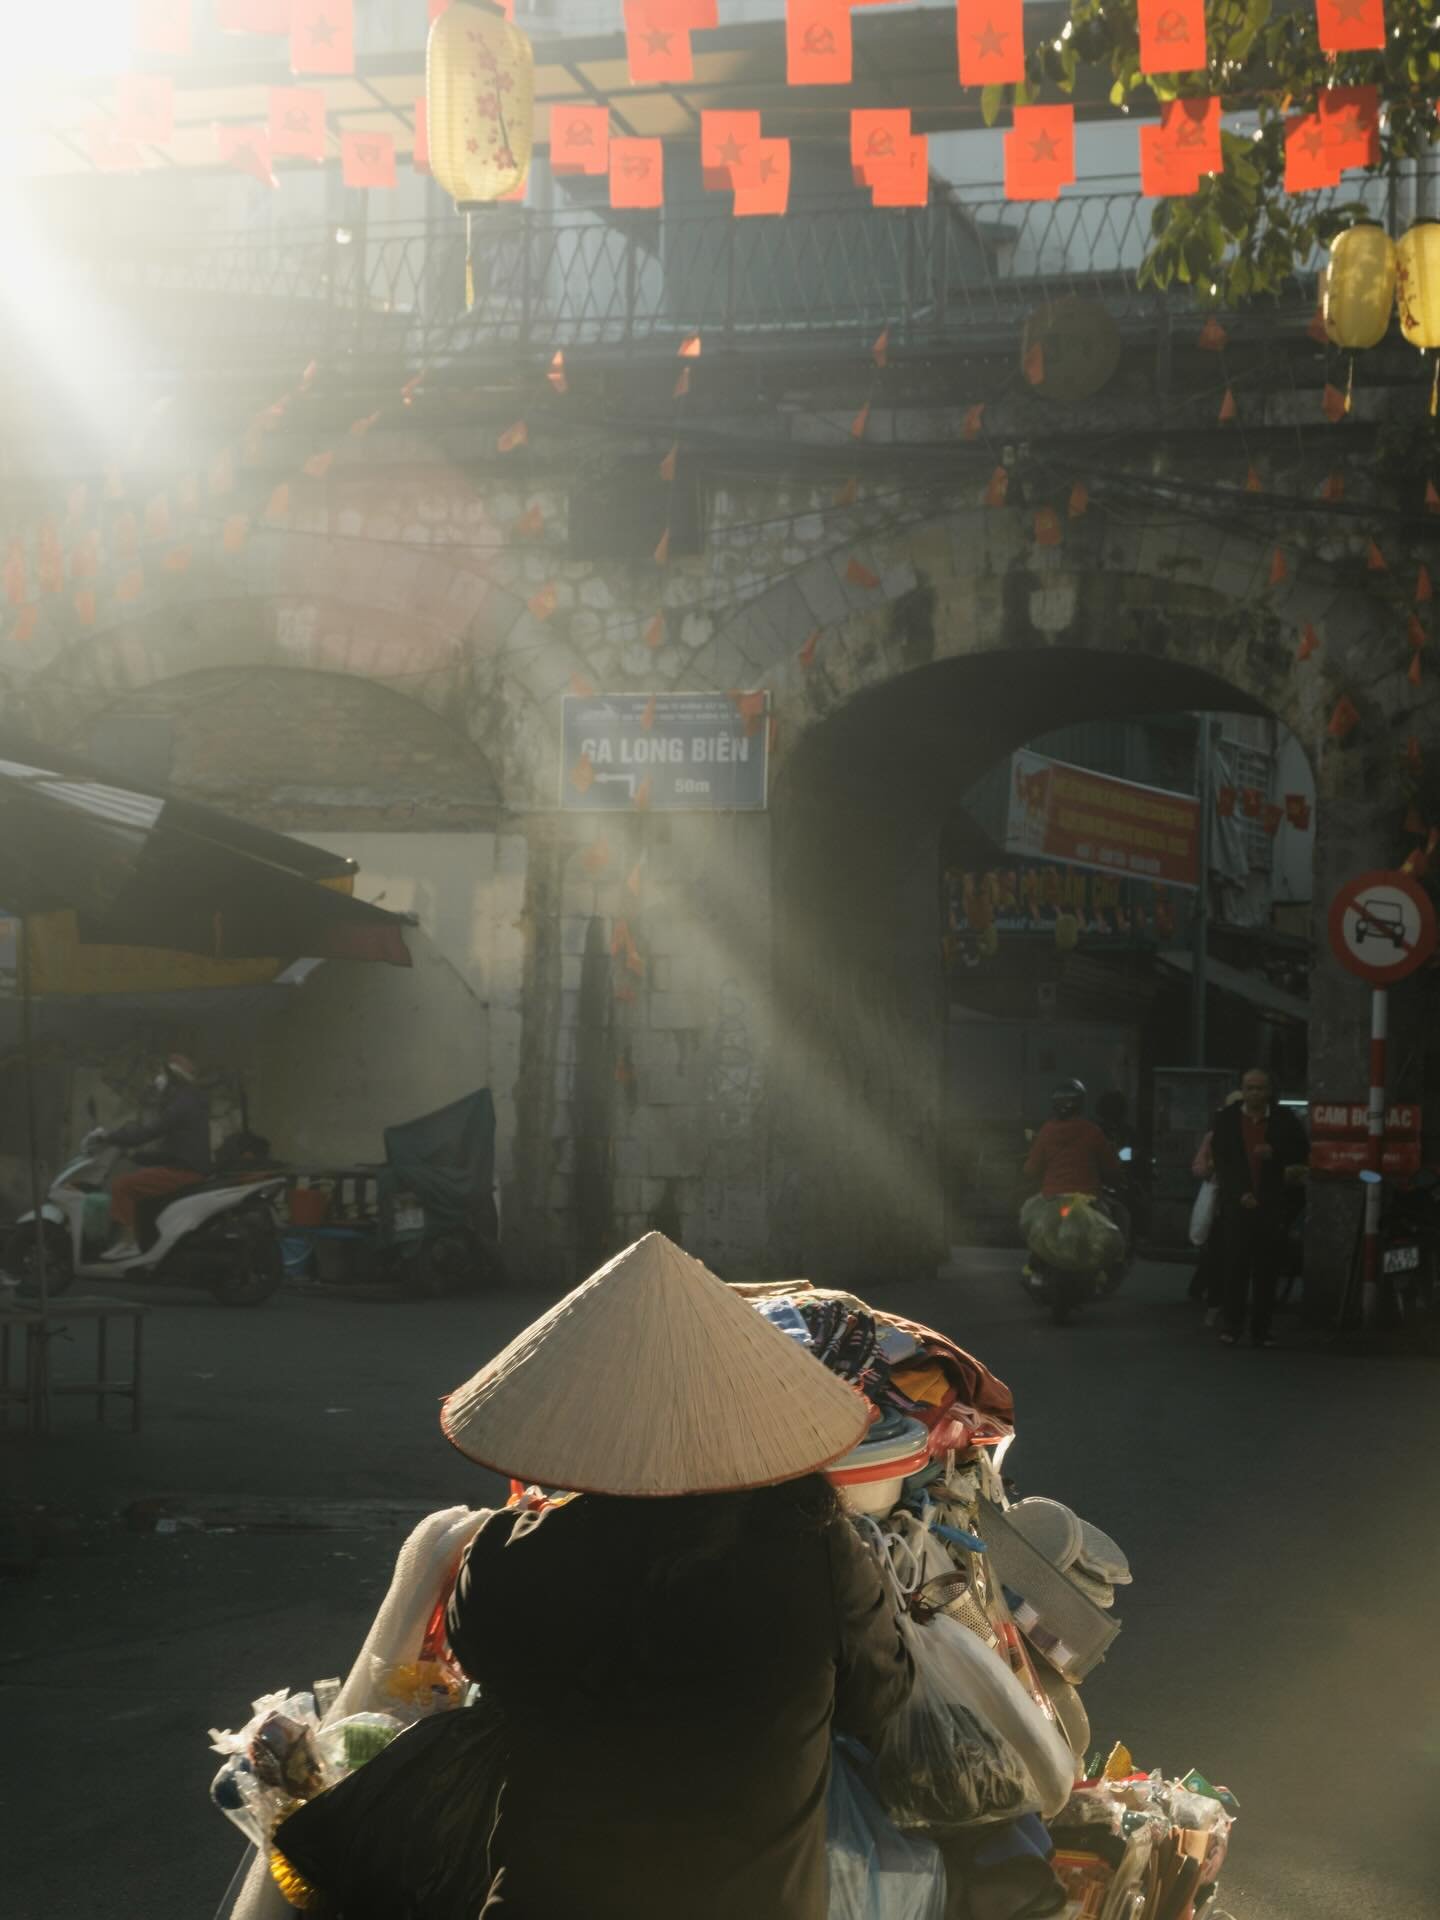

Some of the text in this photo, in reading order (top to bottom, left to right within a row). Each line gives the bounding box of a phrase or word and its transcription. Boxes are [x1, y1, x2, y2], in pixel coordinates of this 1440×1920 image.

[581, 731, 749, 763] GA LONG BIÊN
[675, 779, 710, 793] 50m
